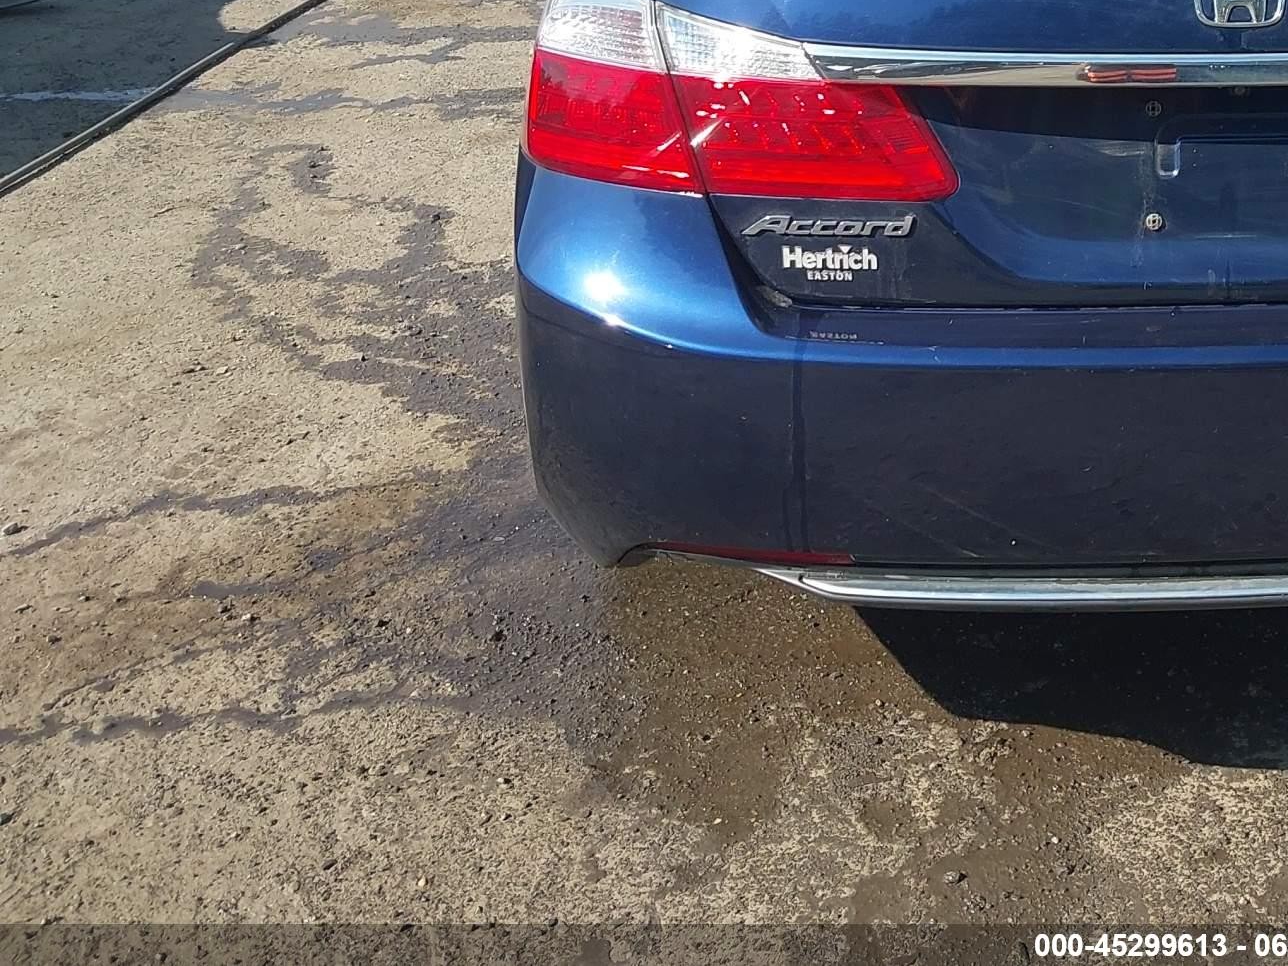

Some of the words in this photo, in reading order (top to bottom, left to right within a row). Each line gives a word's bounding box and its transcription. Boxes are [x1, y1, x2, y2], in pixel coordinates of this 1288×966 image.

[741, 214, 917, 237] Accord
[782, 244, 878, 271] Hertrich
[807, 270, 852, 281] EASTON
